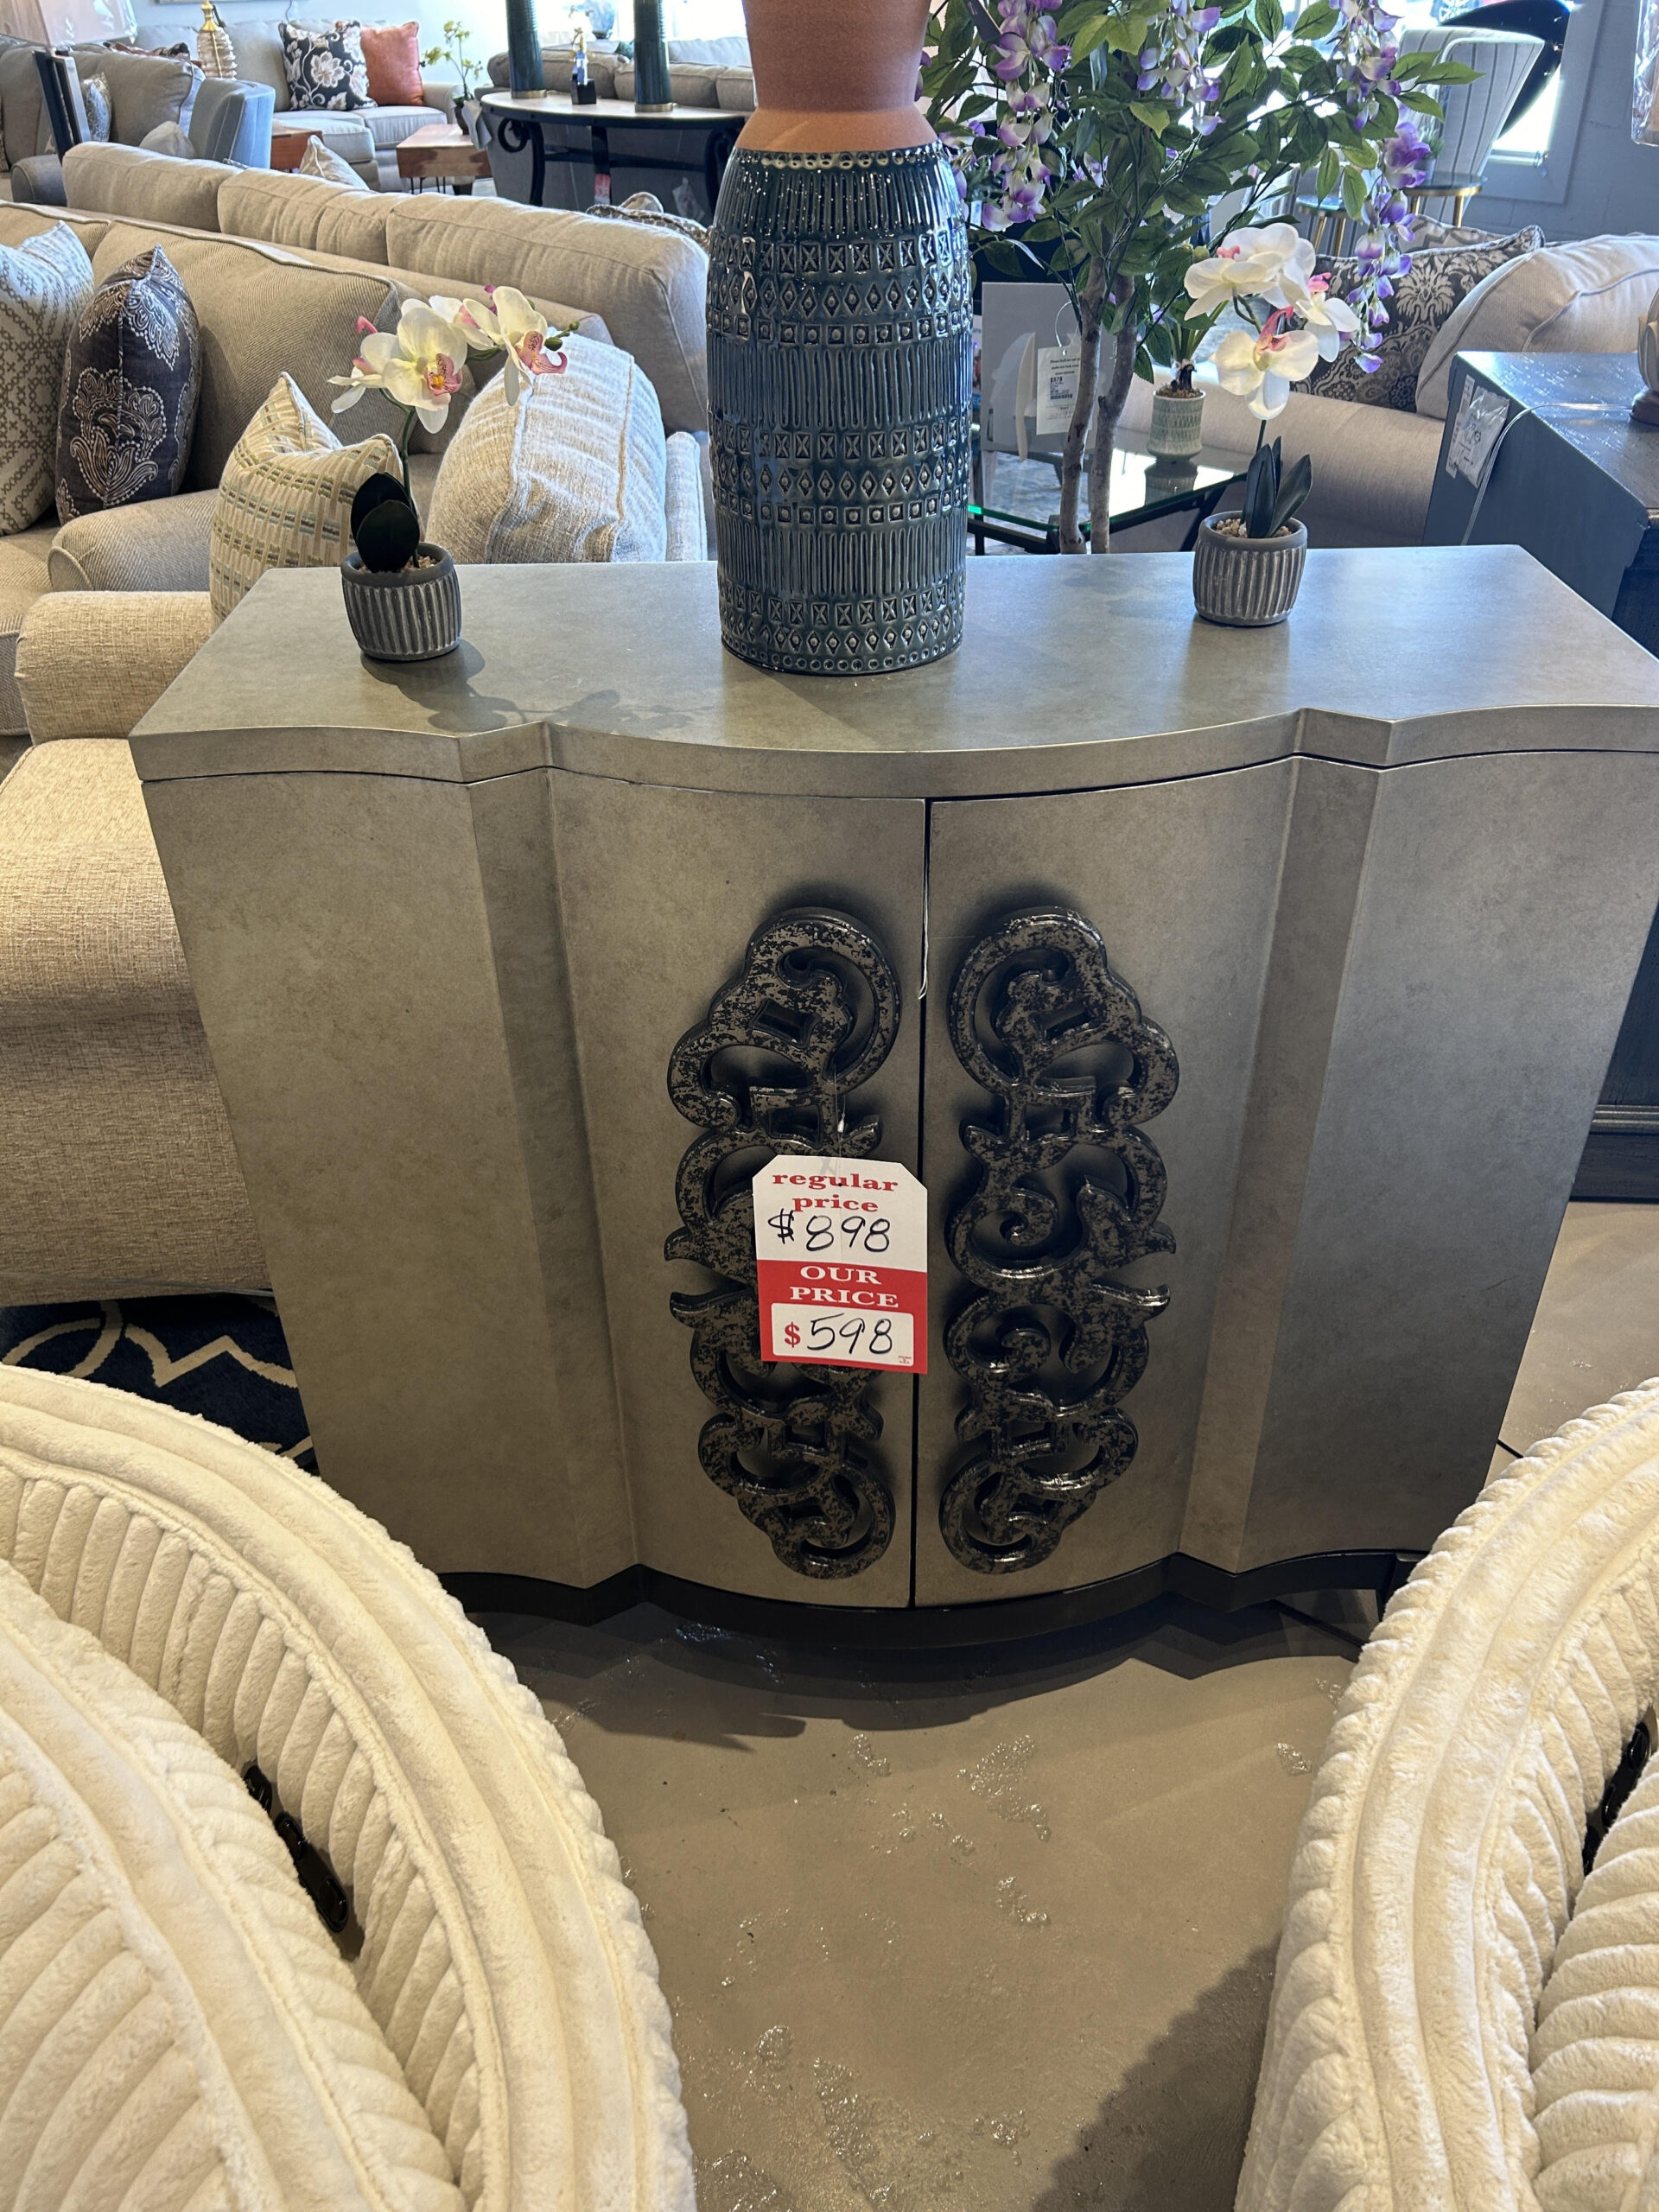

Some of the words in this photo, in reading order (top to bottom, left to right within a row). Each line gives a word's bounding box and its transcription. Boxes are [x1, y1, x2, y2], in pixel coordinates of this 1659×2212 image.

[772, 1173, 899, 1192] regular
[791, 1194, 879, 1212] price
[767, 1208, 891, 1253] $898
[800, 1265, 882, 1285] OUR
[789, 1286, 899, 1308] PRICE
[784, 1313, 893, 1355] $598
